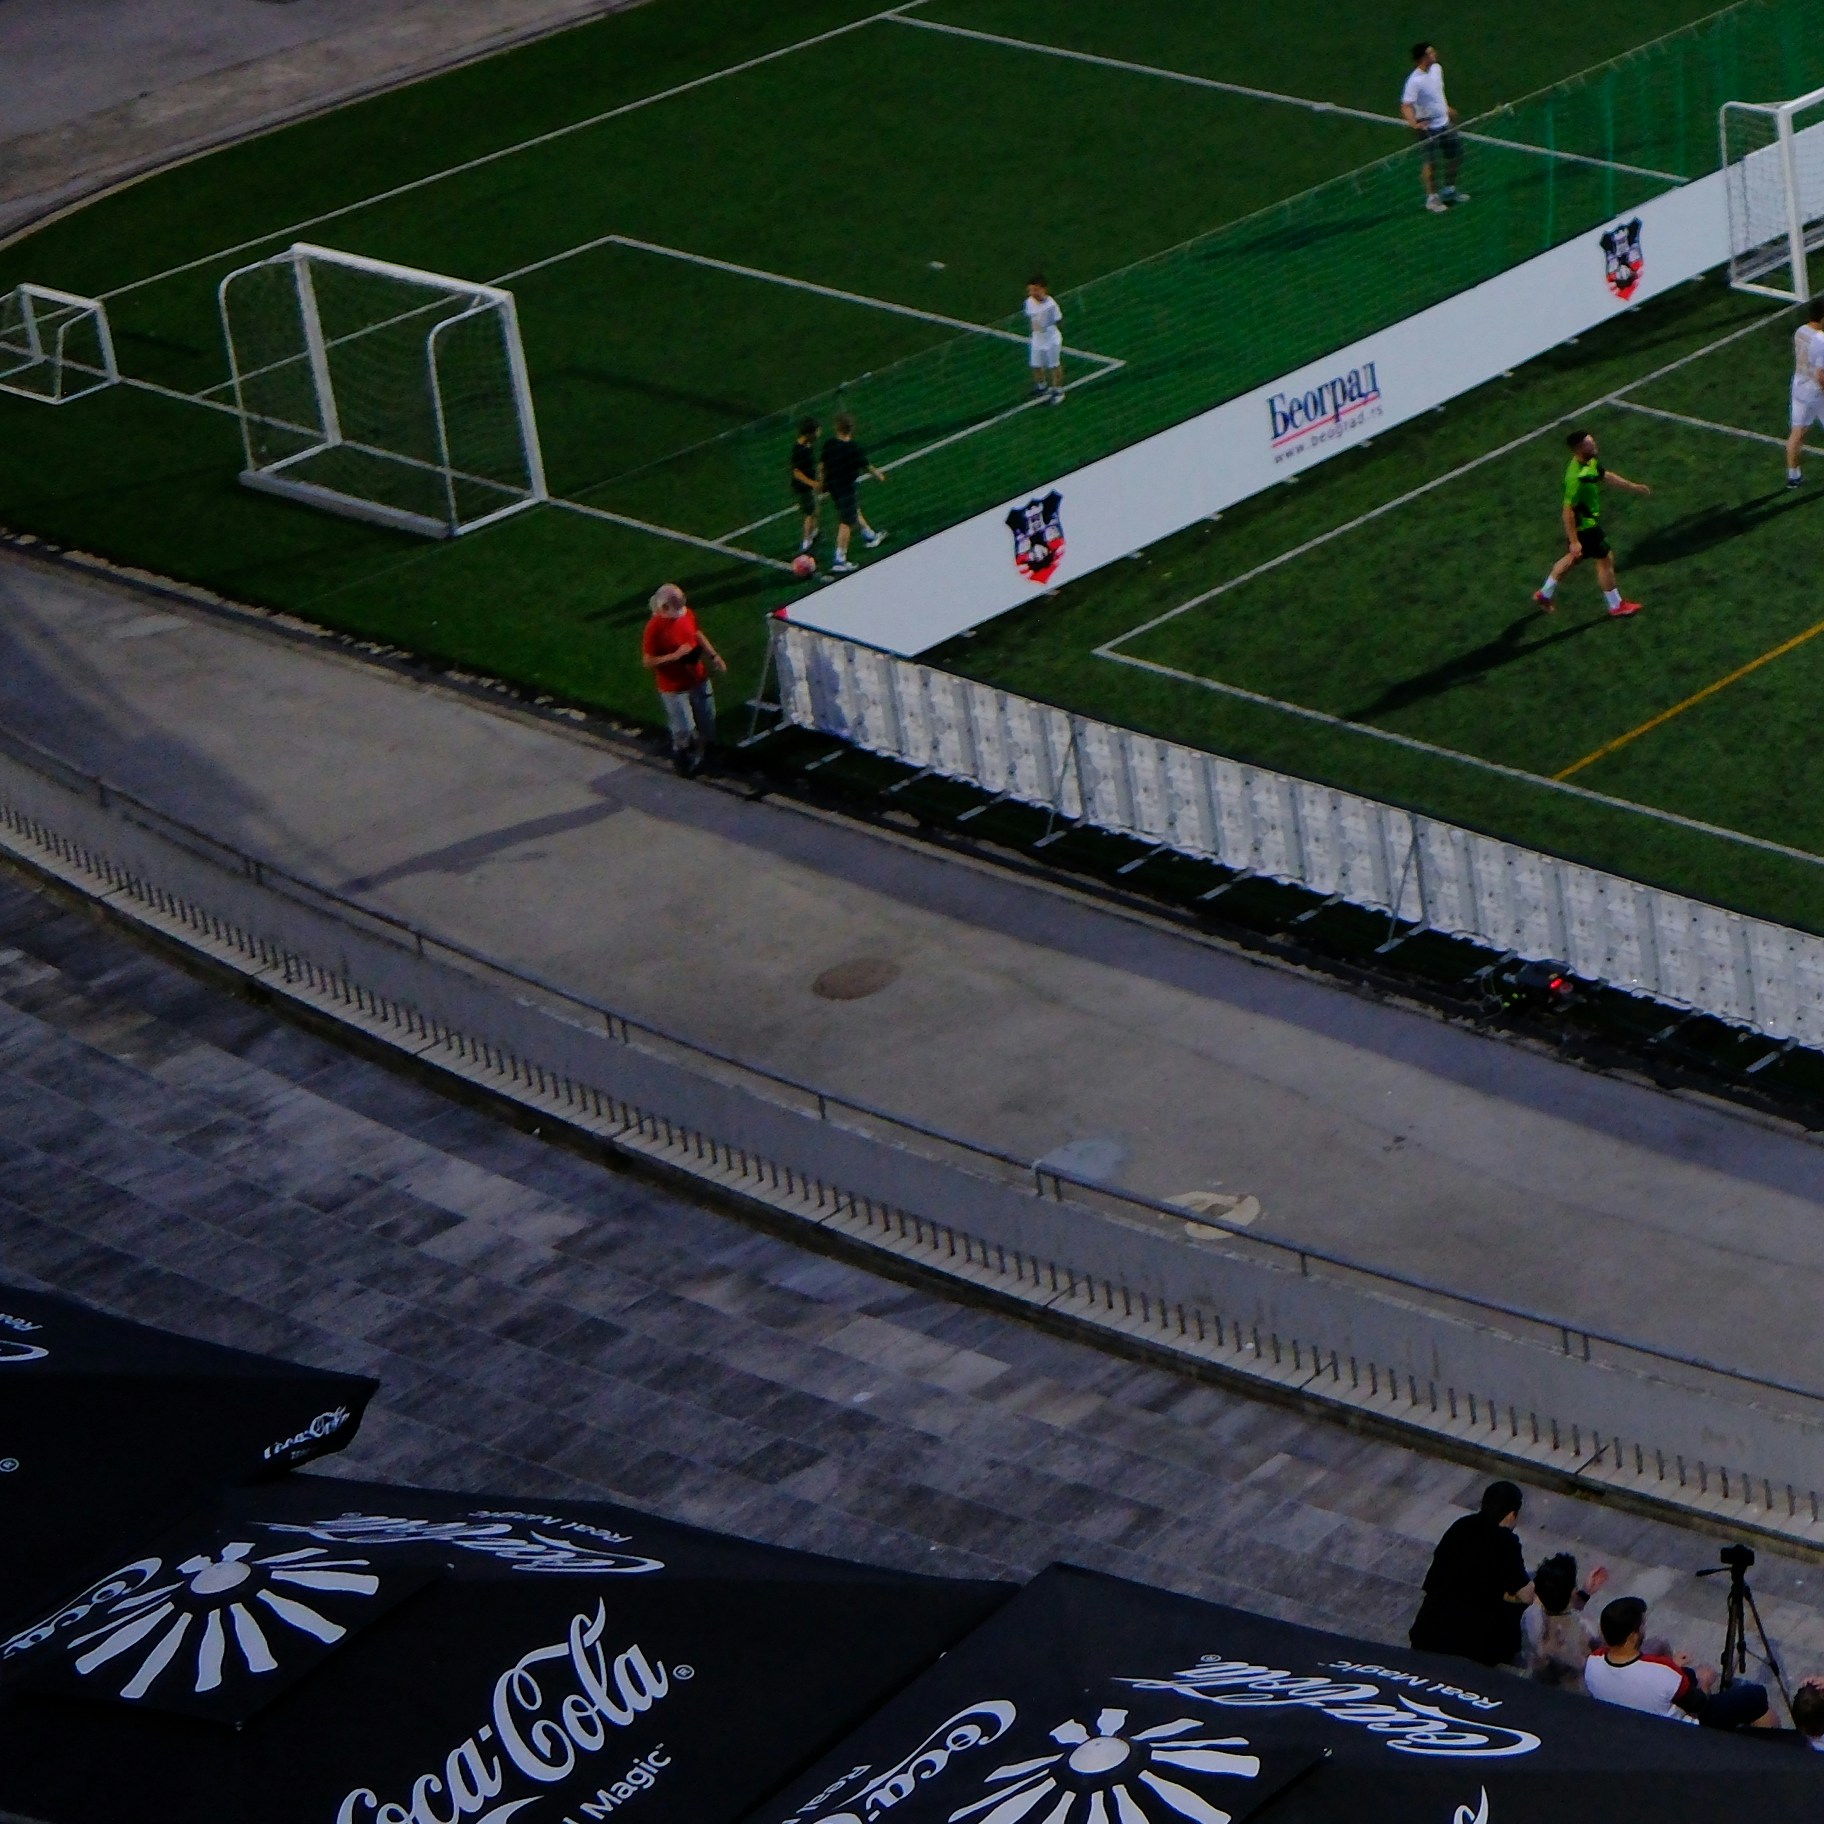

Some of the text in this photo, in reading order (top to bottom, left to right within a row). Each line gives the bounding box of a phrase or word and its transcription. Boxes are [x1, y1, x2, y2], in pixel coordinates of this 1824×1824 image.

[1266, 360, 1380, 439] Београд
[1111, 1660, 1542, 1758] Coca-Cola
[1426, 1682, 1503, 1710] Real
